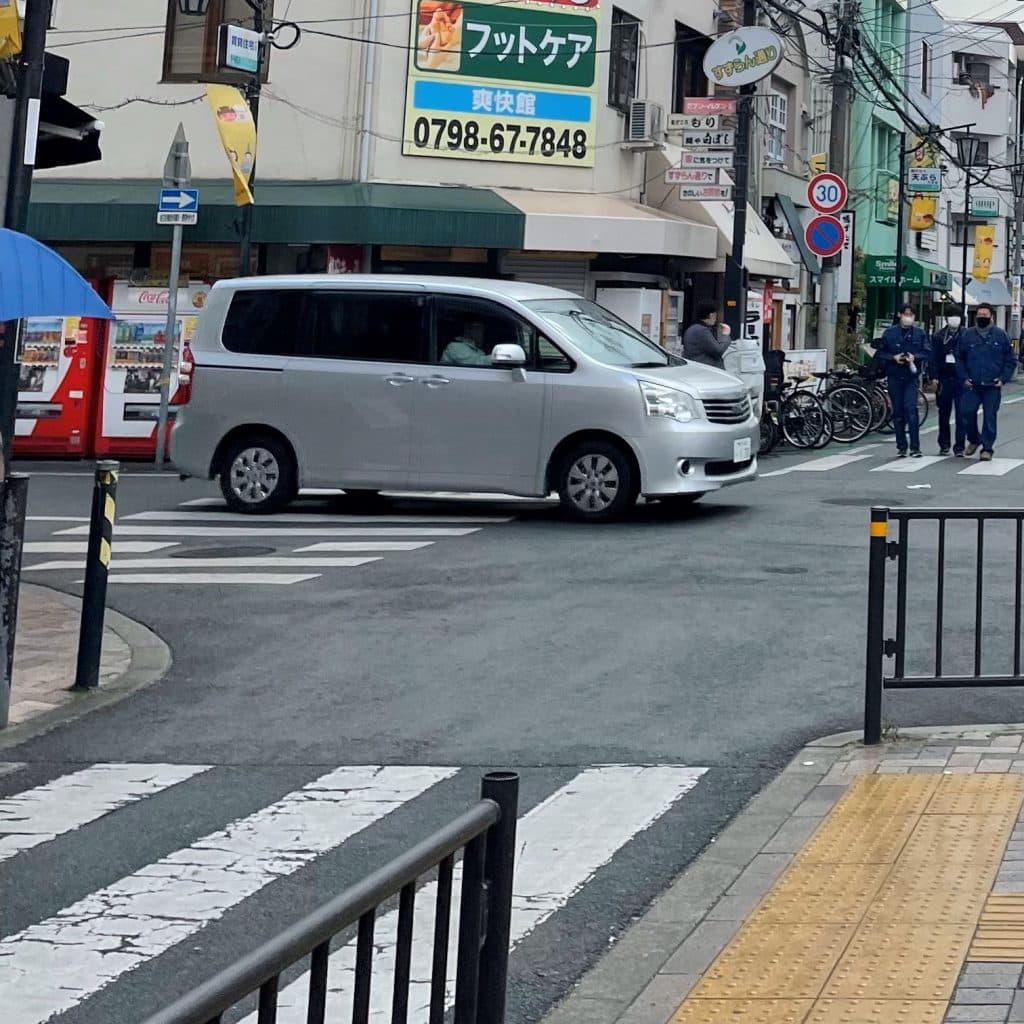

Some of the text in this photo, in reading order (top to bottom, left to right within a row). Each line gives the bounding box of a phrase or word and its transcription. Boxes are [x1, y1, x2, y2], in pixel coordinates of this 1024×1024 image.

[466, 22, 593, 69] フットケア
[711, 45, 777, 81] すずらん通り
[471, 88, 536, 117] 爽快館
[816, 184, 838, 203] 30
